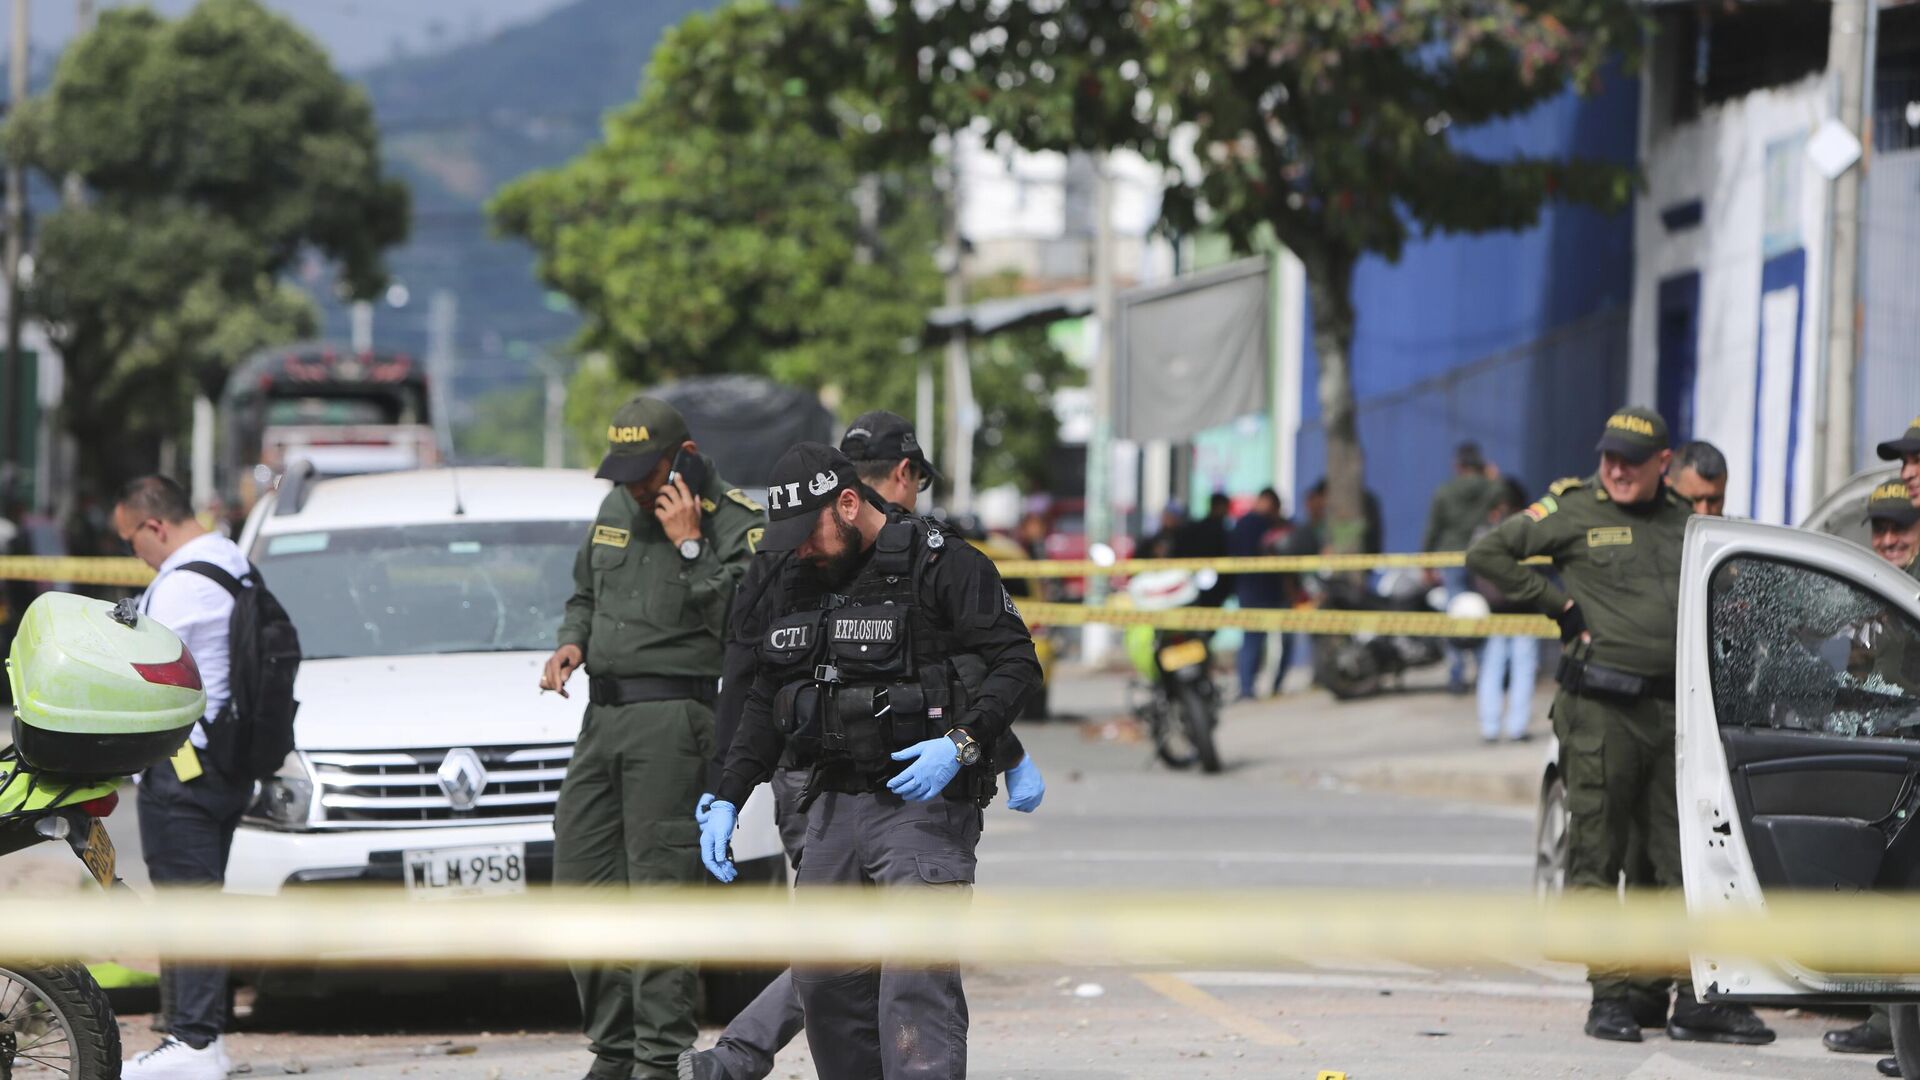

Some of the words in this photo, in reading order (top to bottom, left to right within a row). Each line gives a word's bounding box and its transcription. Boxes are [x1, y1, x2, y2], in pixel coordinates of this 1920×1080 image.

[767, 482, 802, 510] TI
[770, 625, 808, 649] CTI
[834, 619, 893, 640] EXPLOSIVOS
